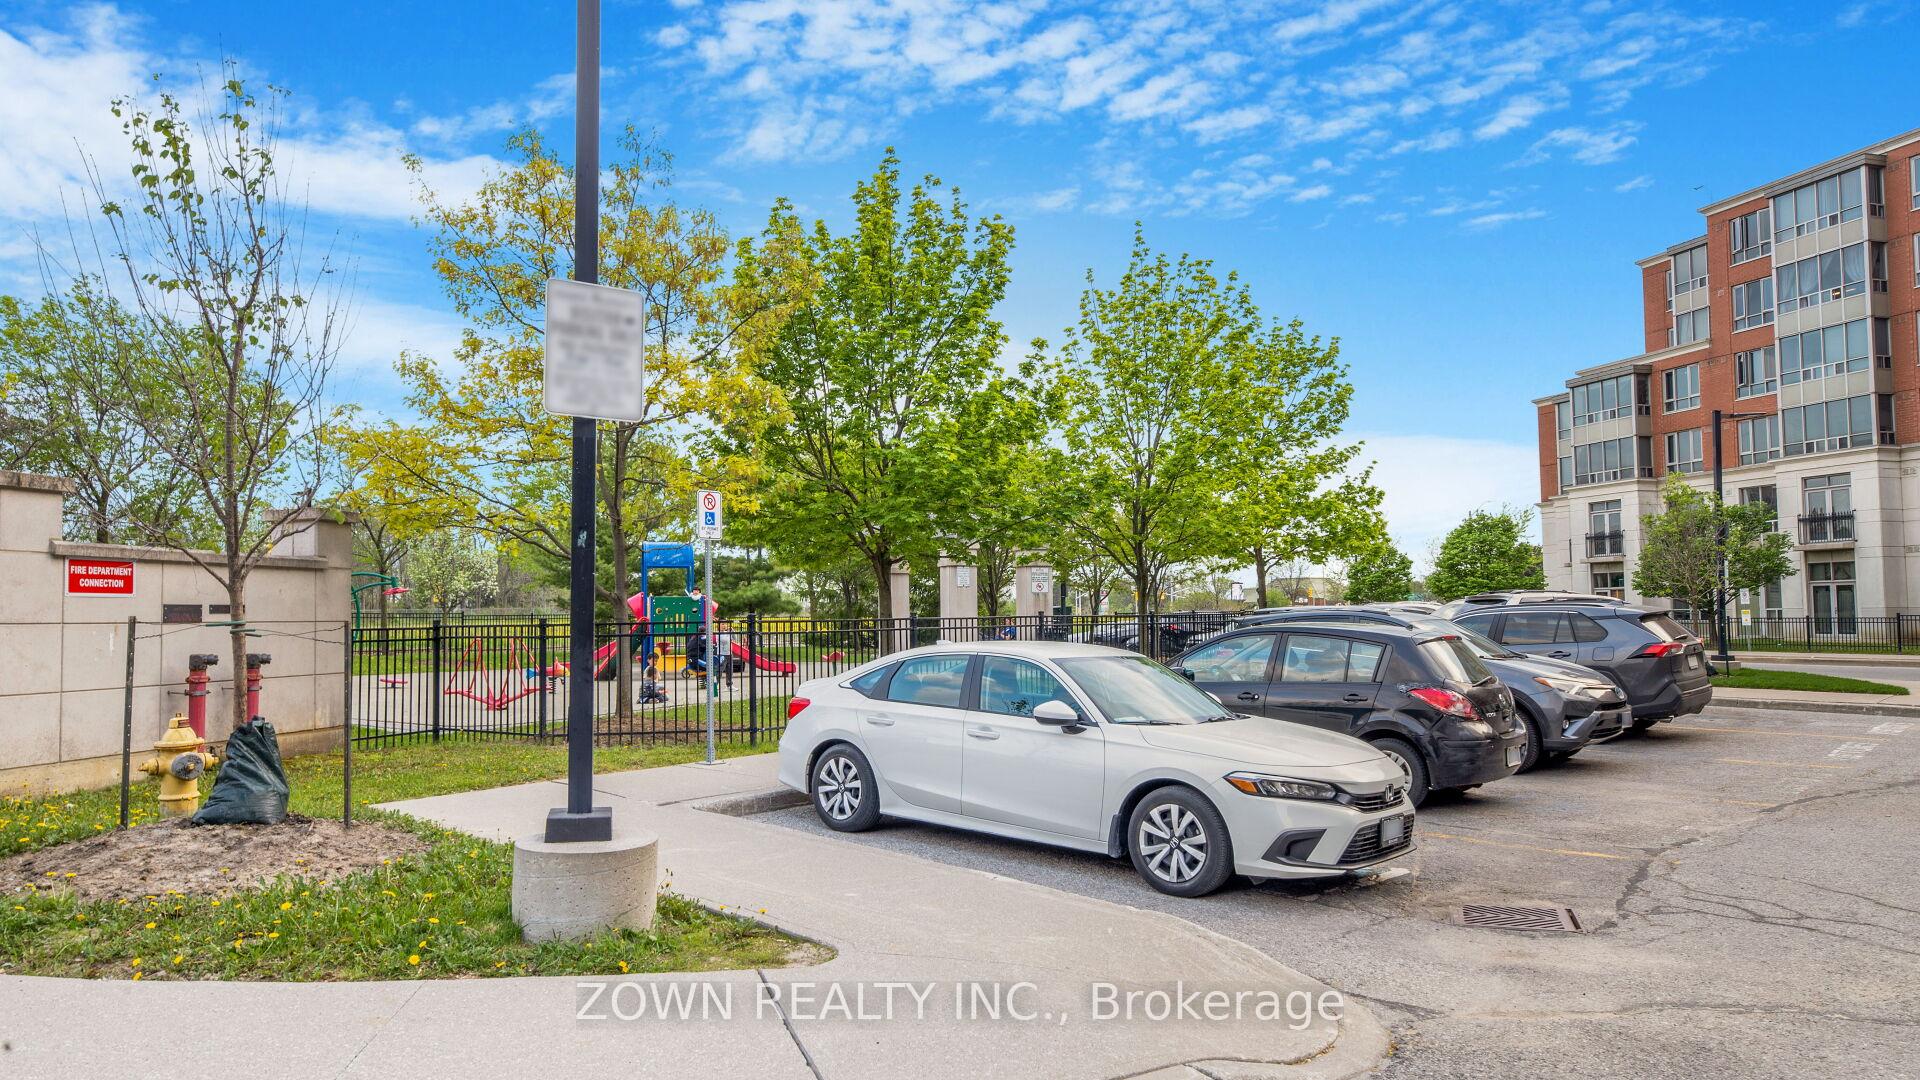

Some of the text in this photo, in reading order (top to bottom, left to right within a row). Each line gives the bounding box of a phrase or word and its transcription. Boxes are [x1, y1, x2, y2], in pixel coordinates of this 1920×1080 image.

[70, 565, 132, 576] FIRE DEPARTMENT
[79, 578, 124, 588] CONNECTION
